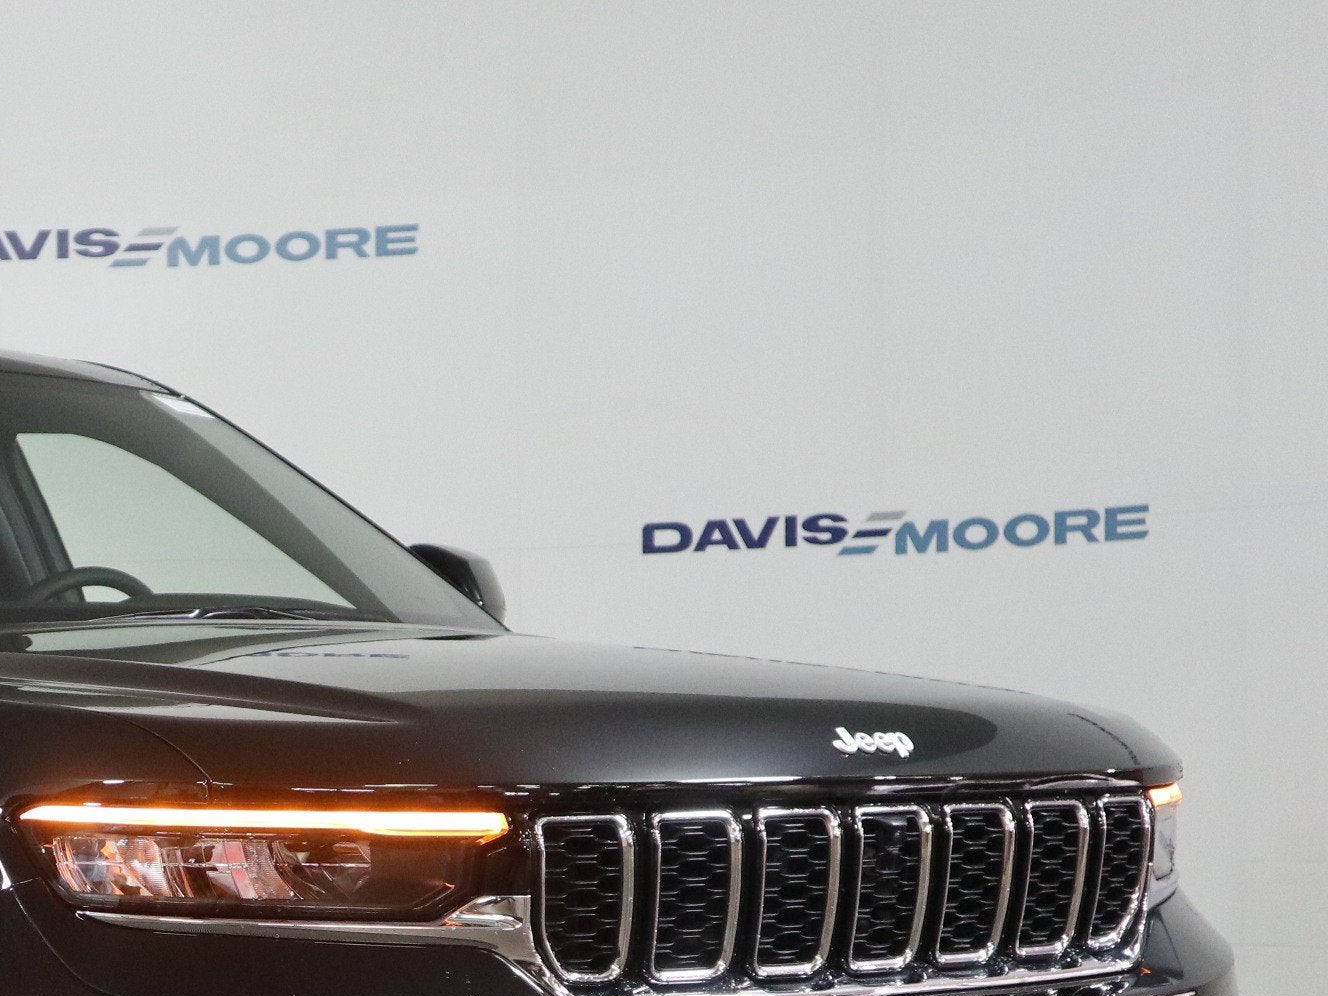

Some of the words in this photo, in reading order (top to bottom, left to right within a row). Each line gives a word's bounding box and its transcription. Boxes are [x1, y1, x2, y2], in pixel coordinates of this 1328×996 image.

[166, 223, 420, 268] MOORE
[641, 513, 849, 555] DAVIS
[894, 504, 1150, 556] MOORE
[832, 726, 914, 758] Jeep
